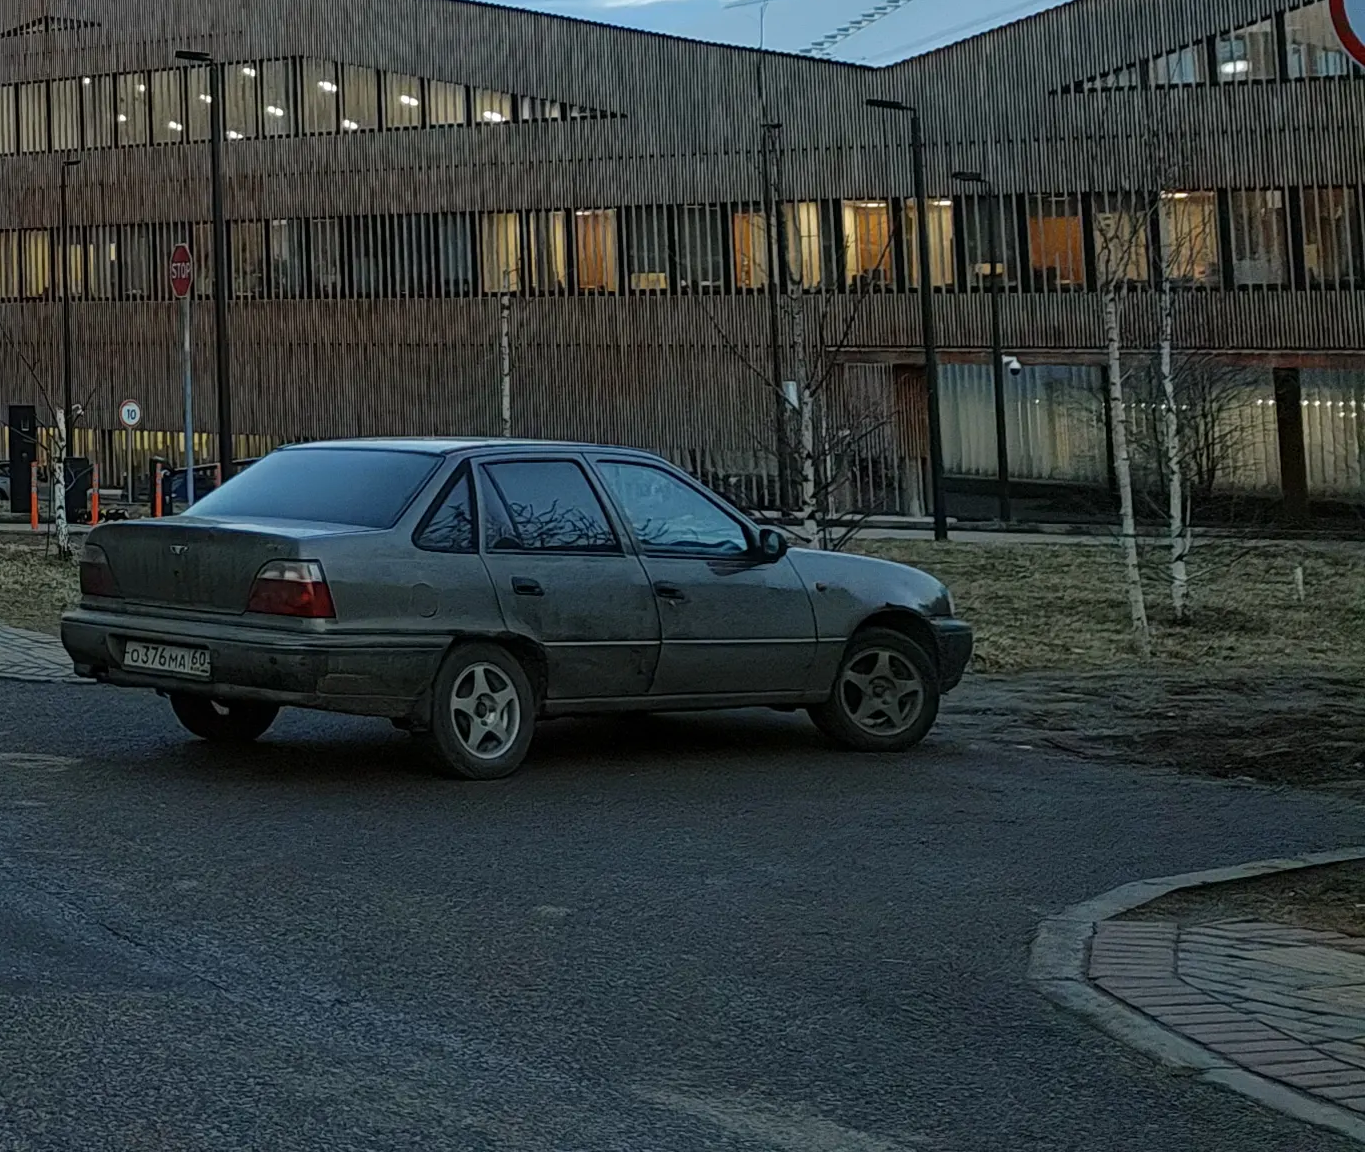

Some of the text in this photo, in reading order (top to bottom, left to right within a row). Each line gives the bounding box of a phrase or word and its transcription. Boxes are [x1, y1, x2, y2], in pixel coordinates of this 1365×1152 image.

[172, 263, 190, 279] STOP
[127, 409, 136, 420] 10
[191, 650, 206, 666] 60
